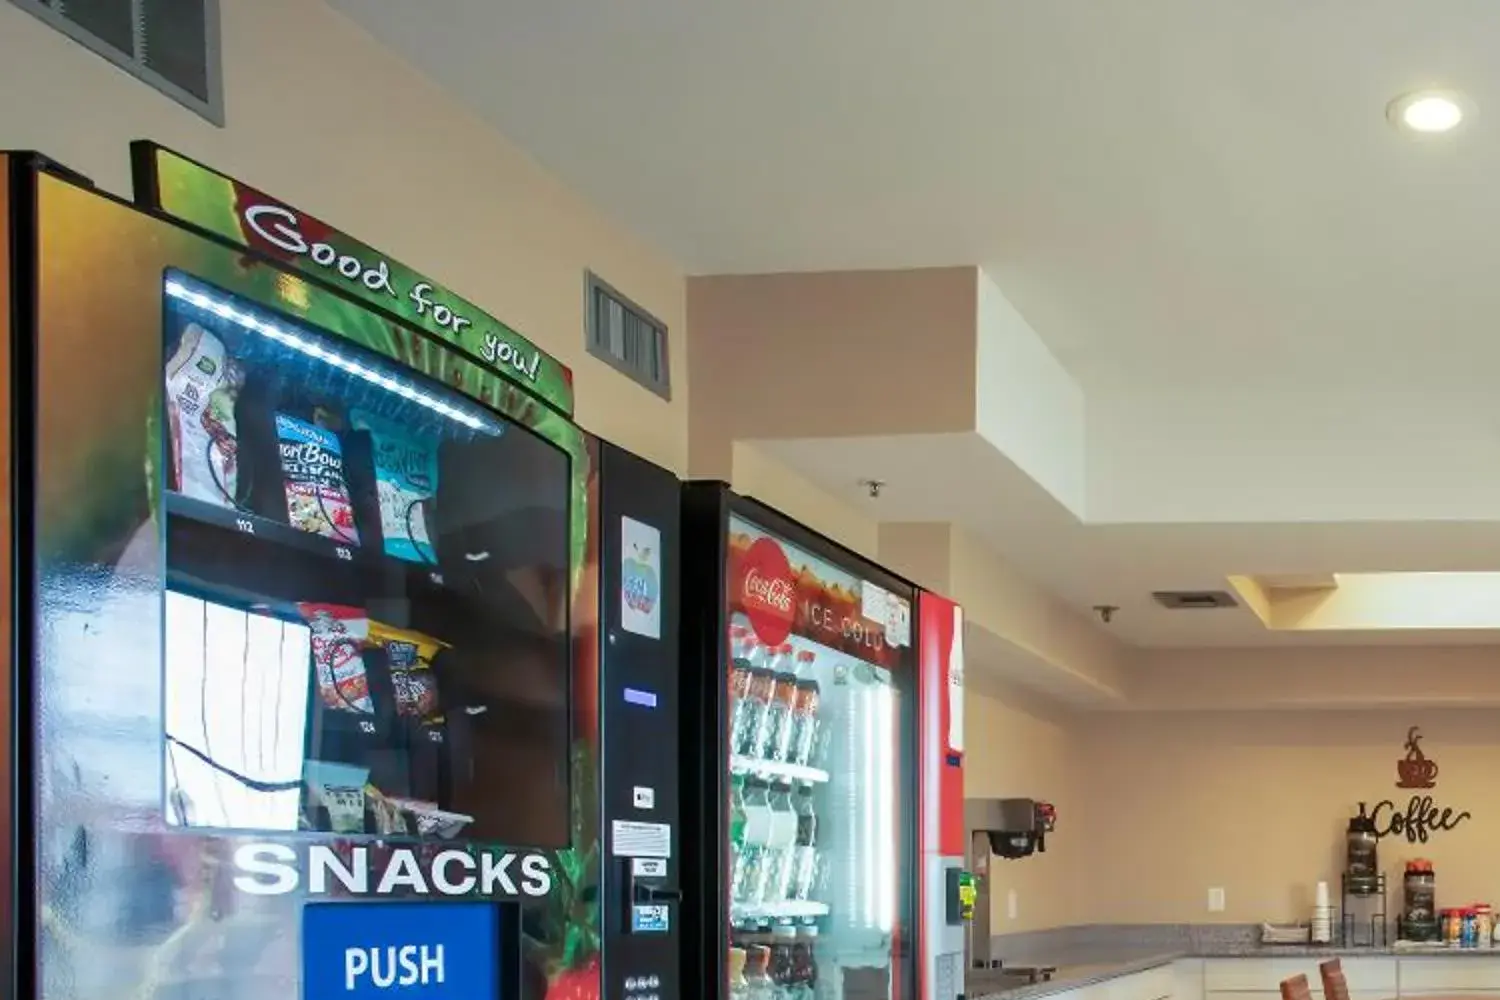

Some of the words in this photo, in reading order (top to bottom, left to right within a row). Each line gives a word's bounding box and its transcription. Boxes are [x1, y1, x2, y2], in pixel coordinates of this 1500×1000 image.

[245, 205, 396, 297] Good
[408, 282, 472, 334] for
[479, 332, 541, 382] you!
[744, 567, 794, 613] Coca-Cola
[803, 598, 833, 631] ICE
[842, 617, 883, 650] COLD
[1370, 795, 1471, 844] Coffee
[233, 844, 551, 895] SNACKS
[345, 944, 445, 991] PUSH
